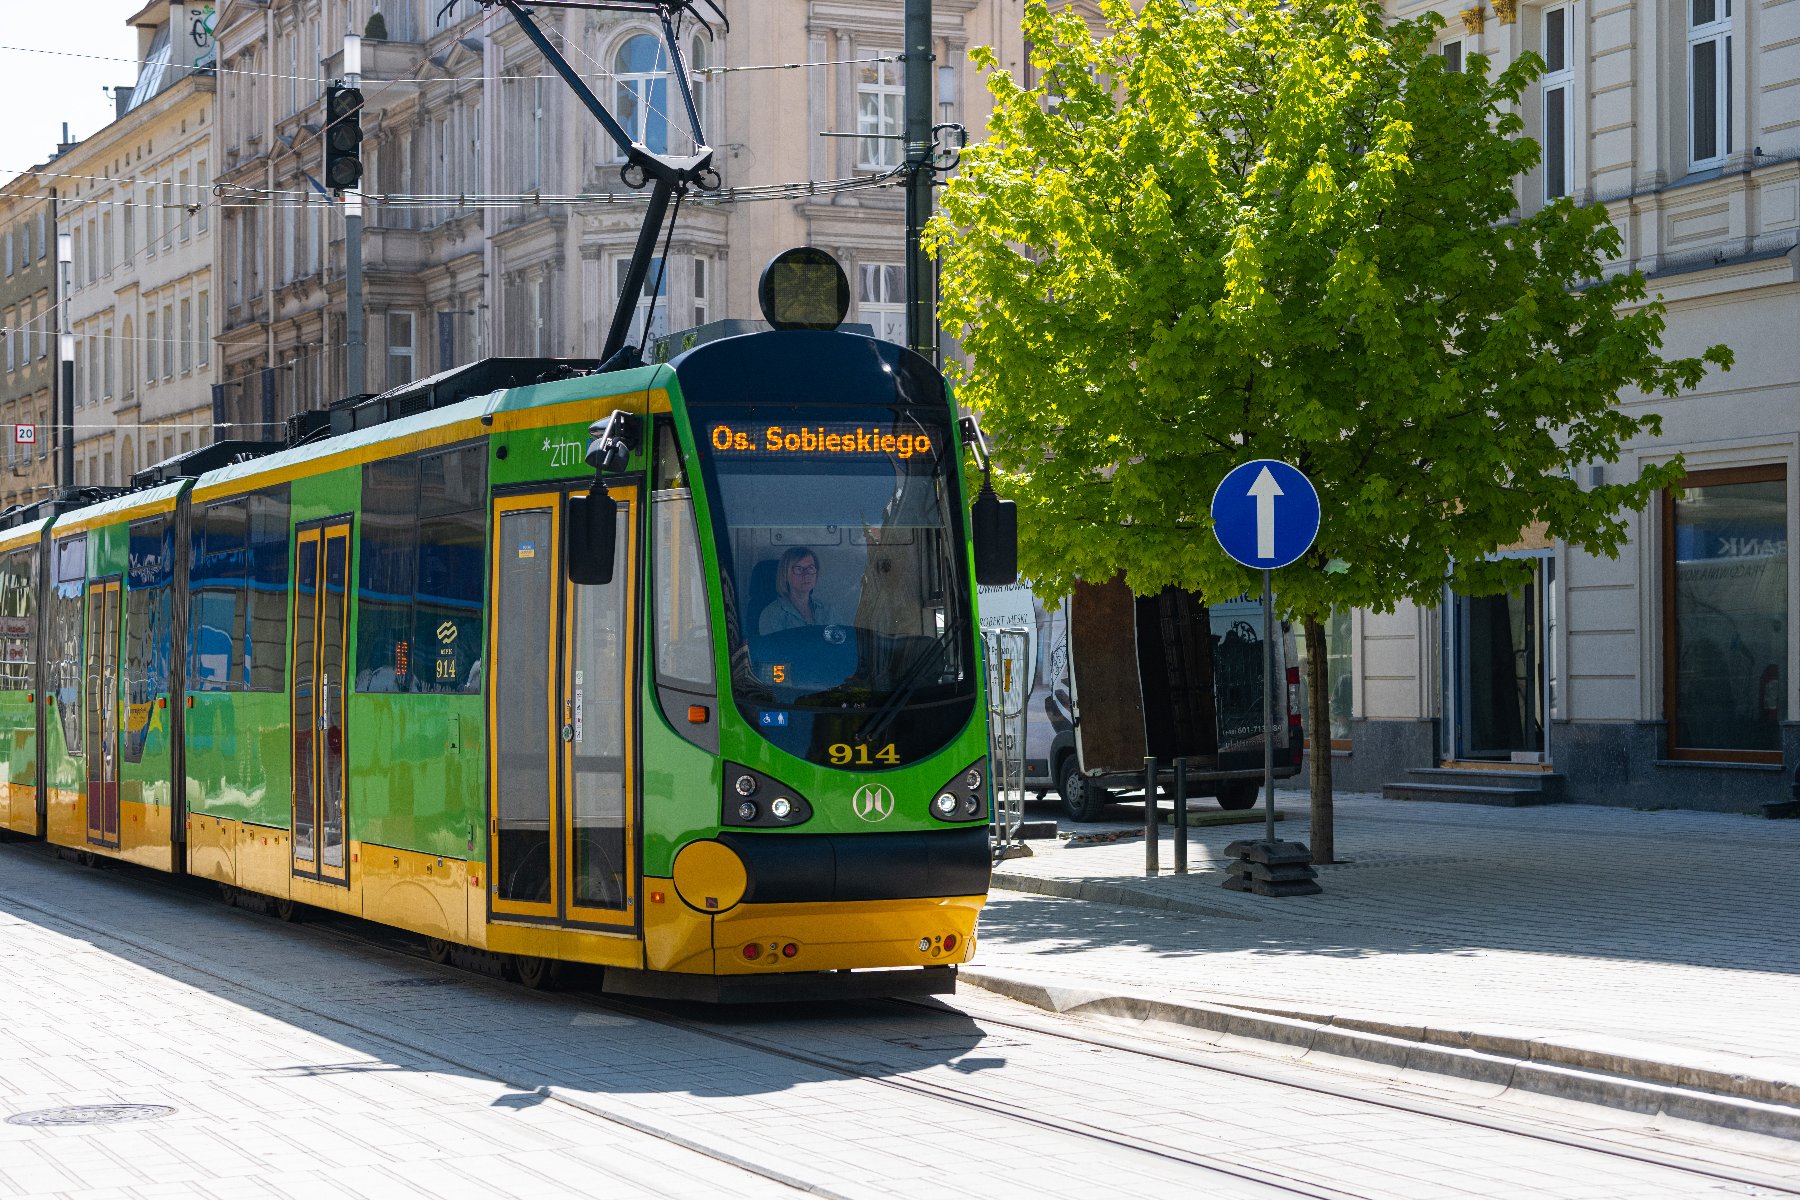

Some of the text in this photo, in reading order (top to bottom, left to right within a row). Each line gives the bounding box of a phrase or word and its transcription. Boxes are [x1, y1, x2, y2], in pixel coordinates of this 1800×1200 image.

[19, 428, 33, 439] 20
[712, 425, 931, 459] Os. Sobieskiego
[980, 615, 1005, 627] ROBERT
[436, 659, 456, 678] 914
[773, 665, 785, 683] 5
[828, 743, 901, 765] 914
